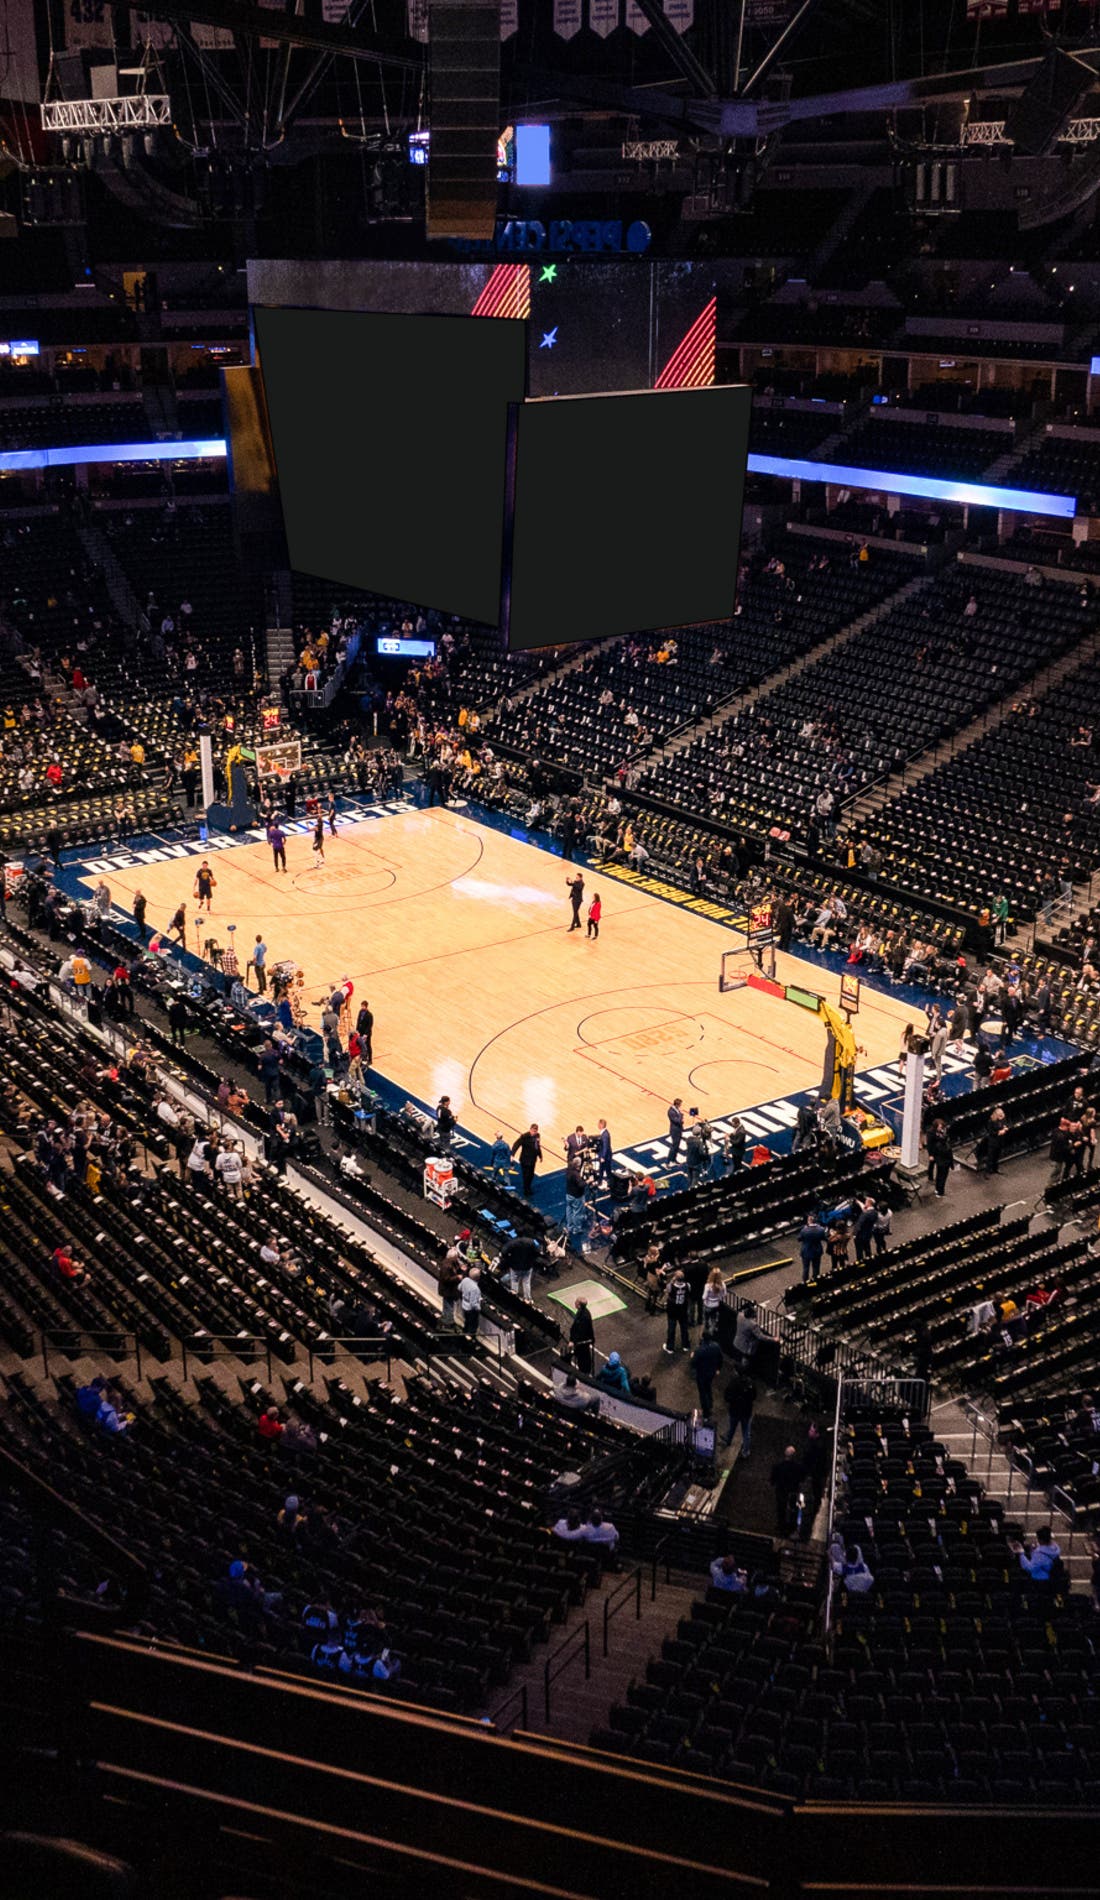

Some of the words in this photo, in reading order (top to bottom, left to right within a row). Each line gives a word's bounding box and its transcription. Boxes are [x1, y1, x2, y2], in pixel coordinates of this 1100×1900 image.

[82, 834, 244, 874] DENVER
[246, 802, 418, 841] NUGGETS
[595, 861, 696, 903] BASKETBALL
[683, 898, 735, 919] HIGH
